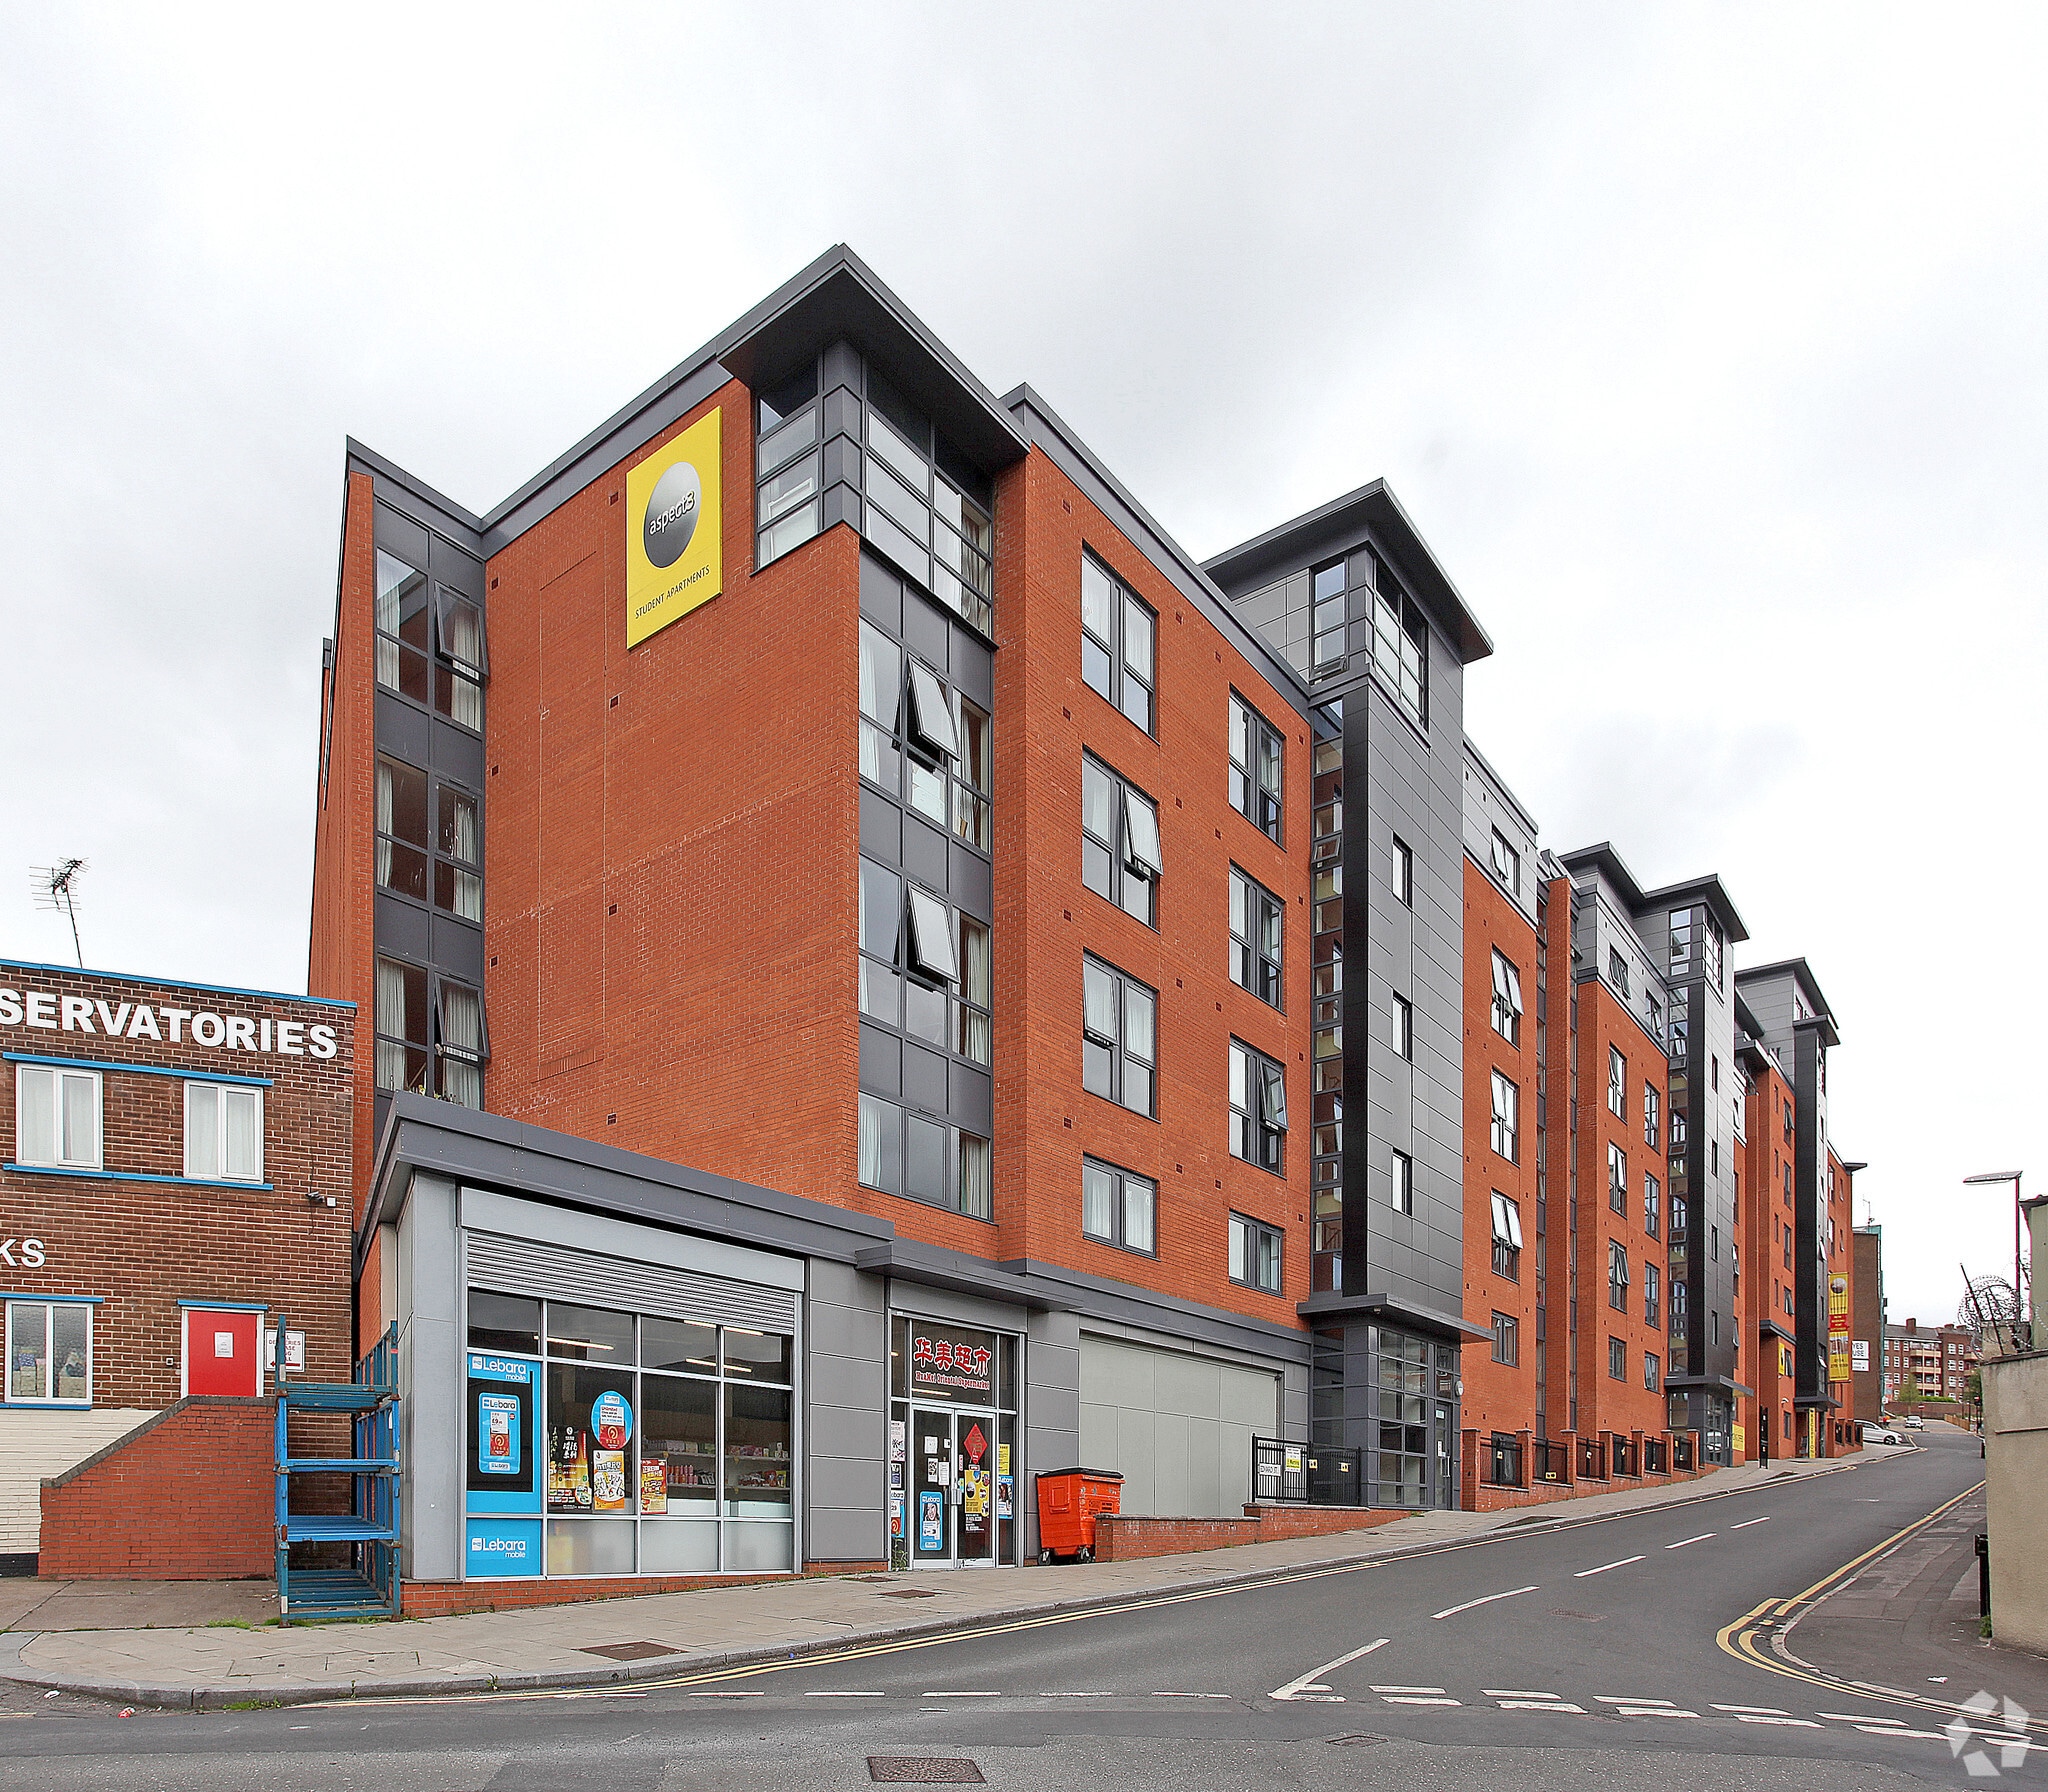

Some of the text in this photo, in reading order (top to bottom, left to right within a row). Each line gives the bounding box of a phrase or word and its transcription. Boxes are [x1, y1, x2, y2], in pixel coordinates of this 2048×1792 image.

[635, 564, 710, 619] STUDENT APARTMENTS
[0, 988, 339, 1060] SERVATORIES
[0, 1238, 46, 1268] KS
[483, 1357, 527, 1375] Lebara
[913, 1336, 992, 1378] 华美超市
[505, 1374, 527, 1382] mobile
[489, 1400, 516, 1410] Lebara
[482, 1537, 527, 1551] Lebara
